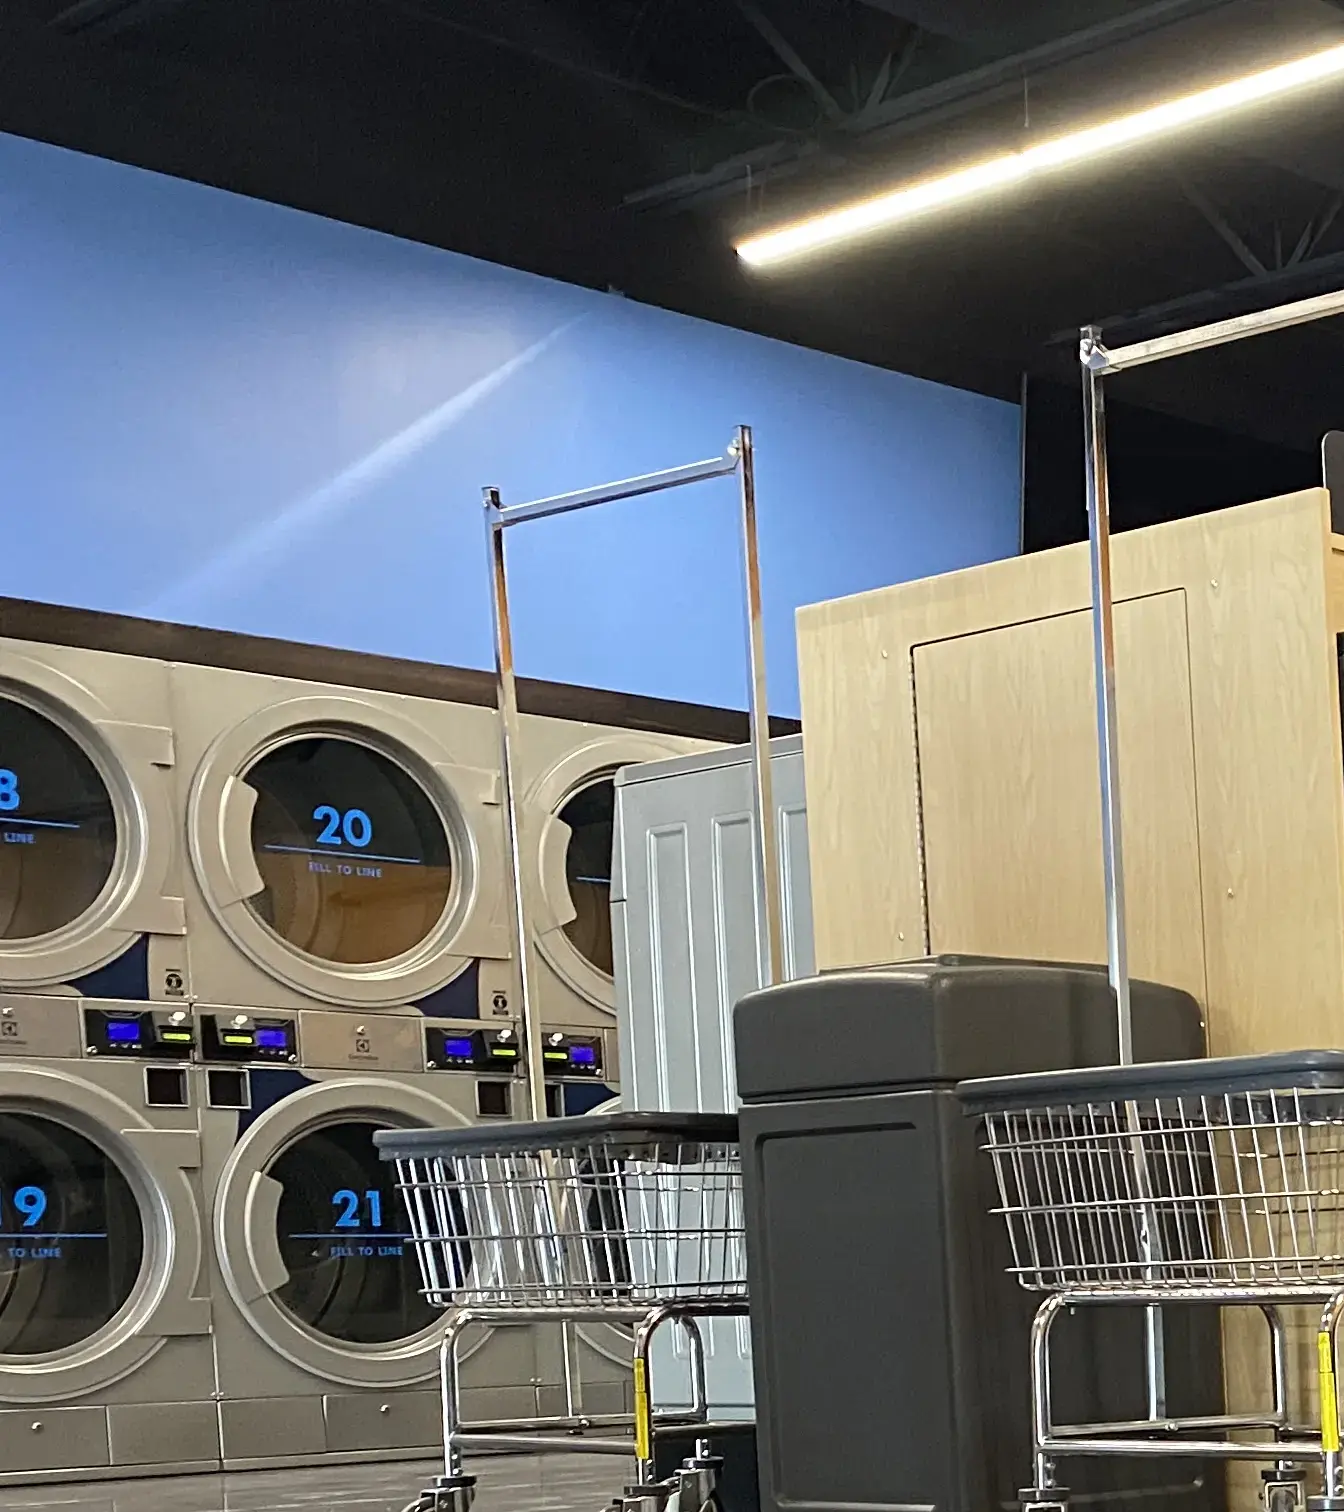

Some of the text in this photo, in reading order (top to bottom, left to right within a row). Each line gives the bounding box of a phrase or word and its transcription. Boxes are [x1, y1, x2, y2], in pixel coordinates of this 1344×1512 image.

[313, 805, 372, 848] 20
[337, 864, 352, 875] TO
[356, 866, 383, 878] LINE
[0, 1186, 47, 1227] 9
[332, 1189, 382, 1227] 21
[8, 1247, 26, 1258] TO
[330, 1246, 404, 1257] FILL TO LINE
